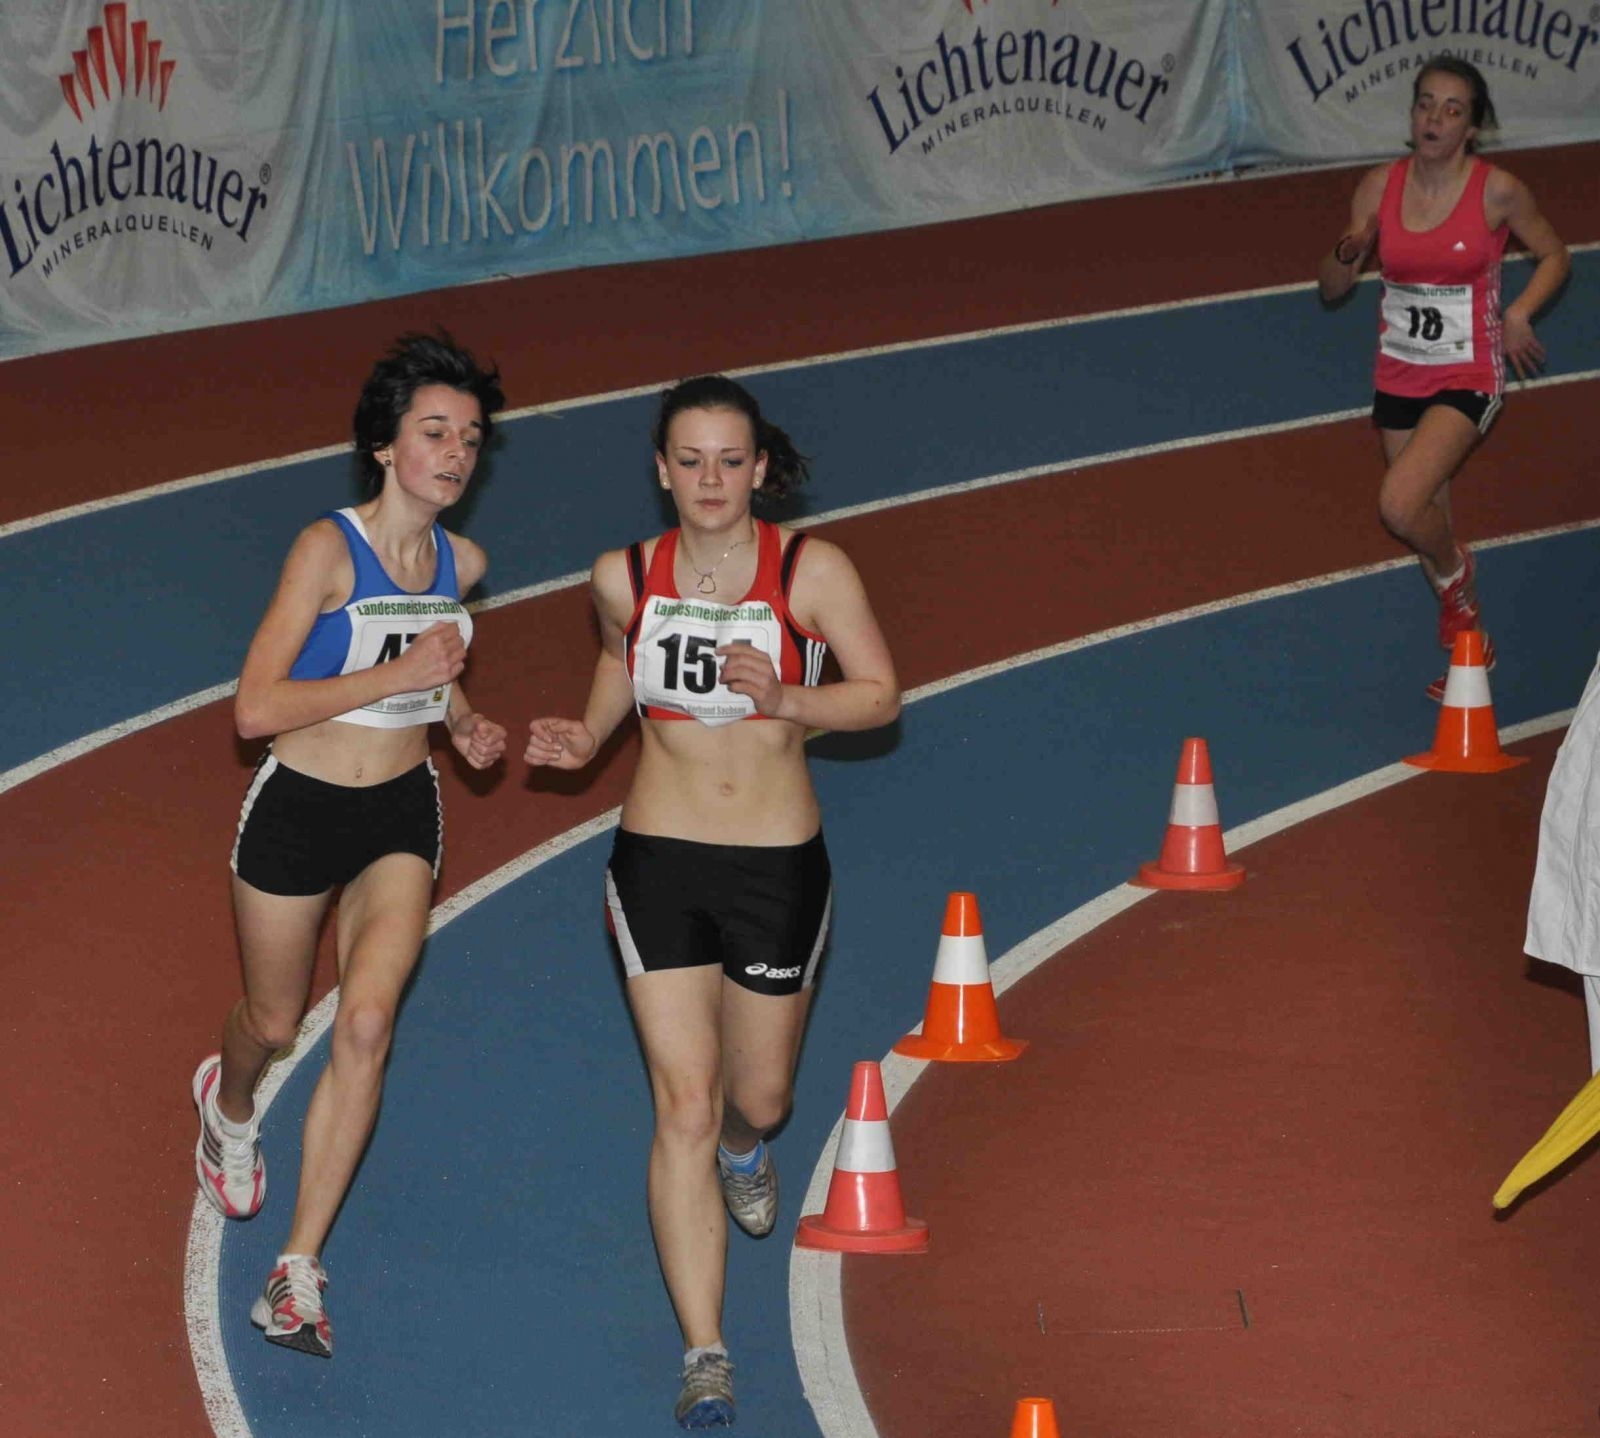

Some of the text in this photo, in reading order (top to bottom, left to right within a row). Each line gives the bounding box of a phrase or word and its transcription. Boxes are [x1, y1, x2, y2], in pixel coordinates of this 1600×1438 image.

[867, 25, 1169, 154] Lichtenauer
[921, 97, 1107, 154] MINERALQUELLEN
[347, 88, 793, 255] Willkommen!
[42, 215, 214, 279] MINERALQUELLEN
[1405, 305, 1444, 341] 18
[356, 600, 464, 616] Landesmeisterschaft
[654, 600, 773, 622] Landesmeisterschaft
[657, 633, 753, 694] 15
[765, 965, 801, 979] asics
